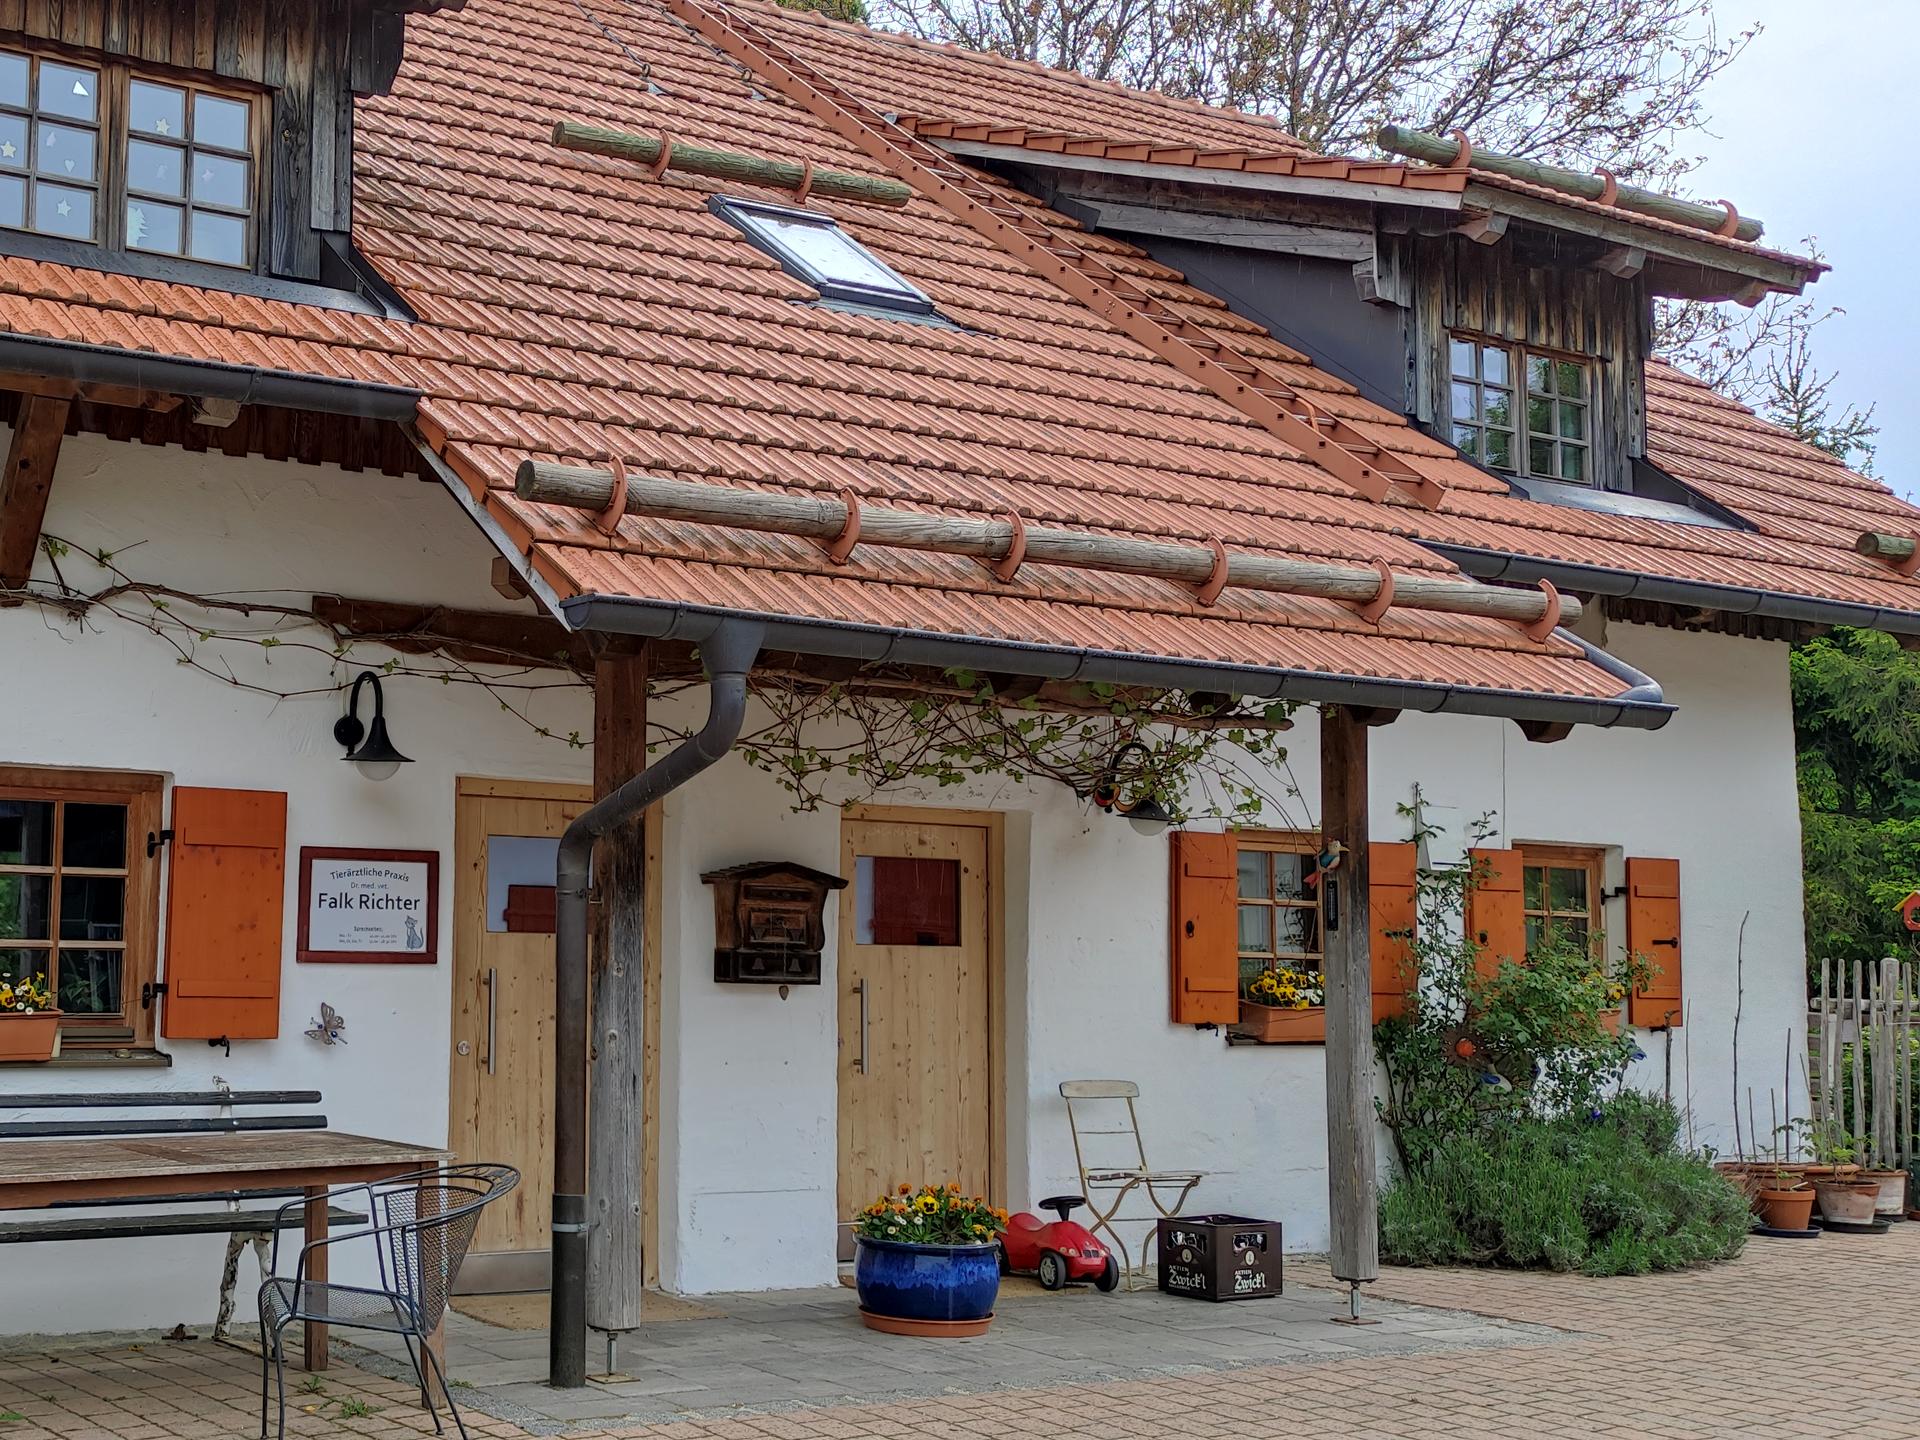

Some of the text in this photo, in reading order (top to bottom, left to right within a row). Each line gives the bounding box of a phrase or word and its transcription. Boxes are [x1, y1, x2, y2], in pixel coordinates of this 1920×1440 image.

[330, 867, 409, 882] Tierärztliche Praxis
[318, 892, 420, 910] Falk Richter
